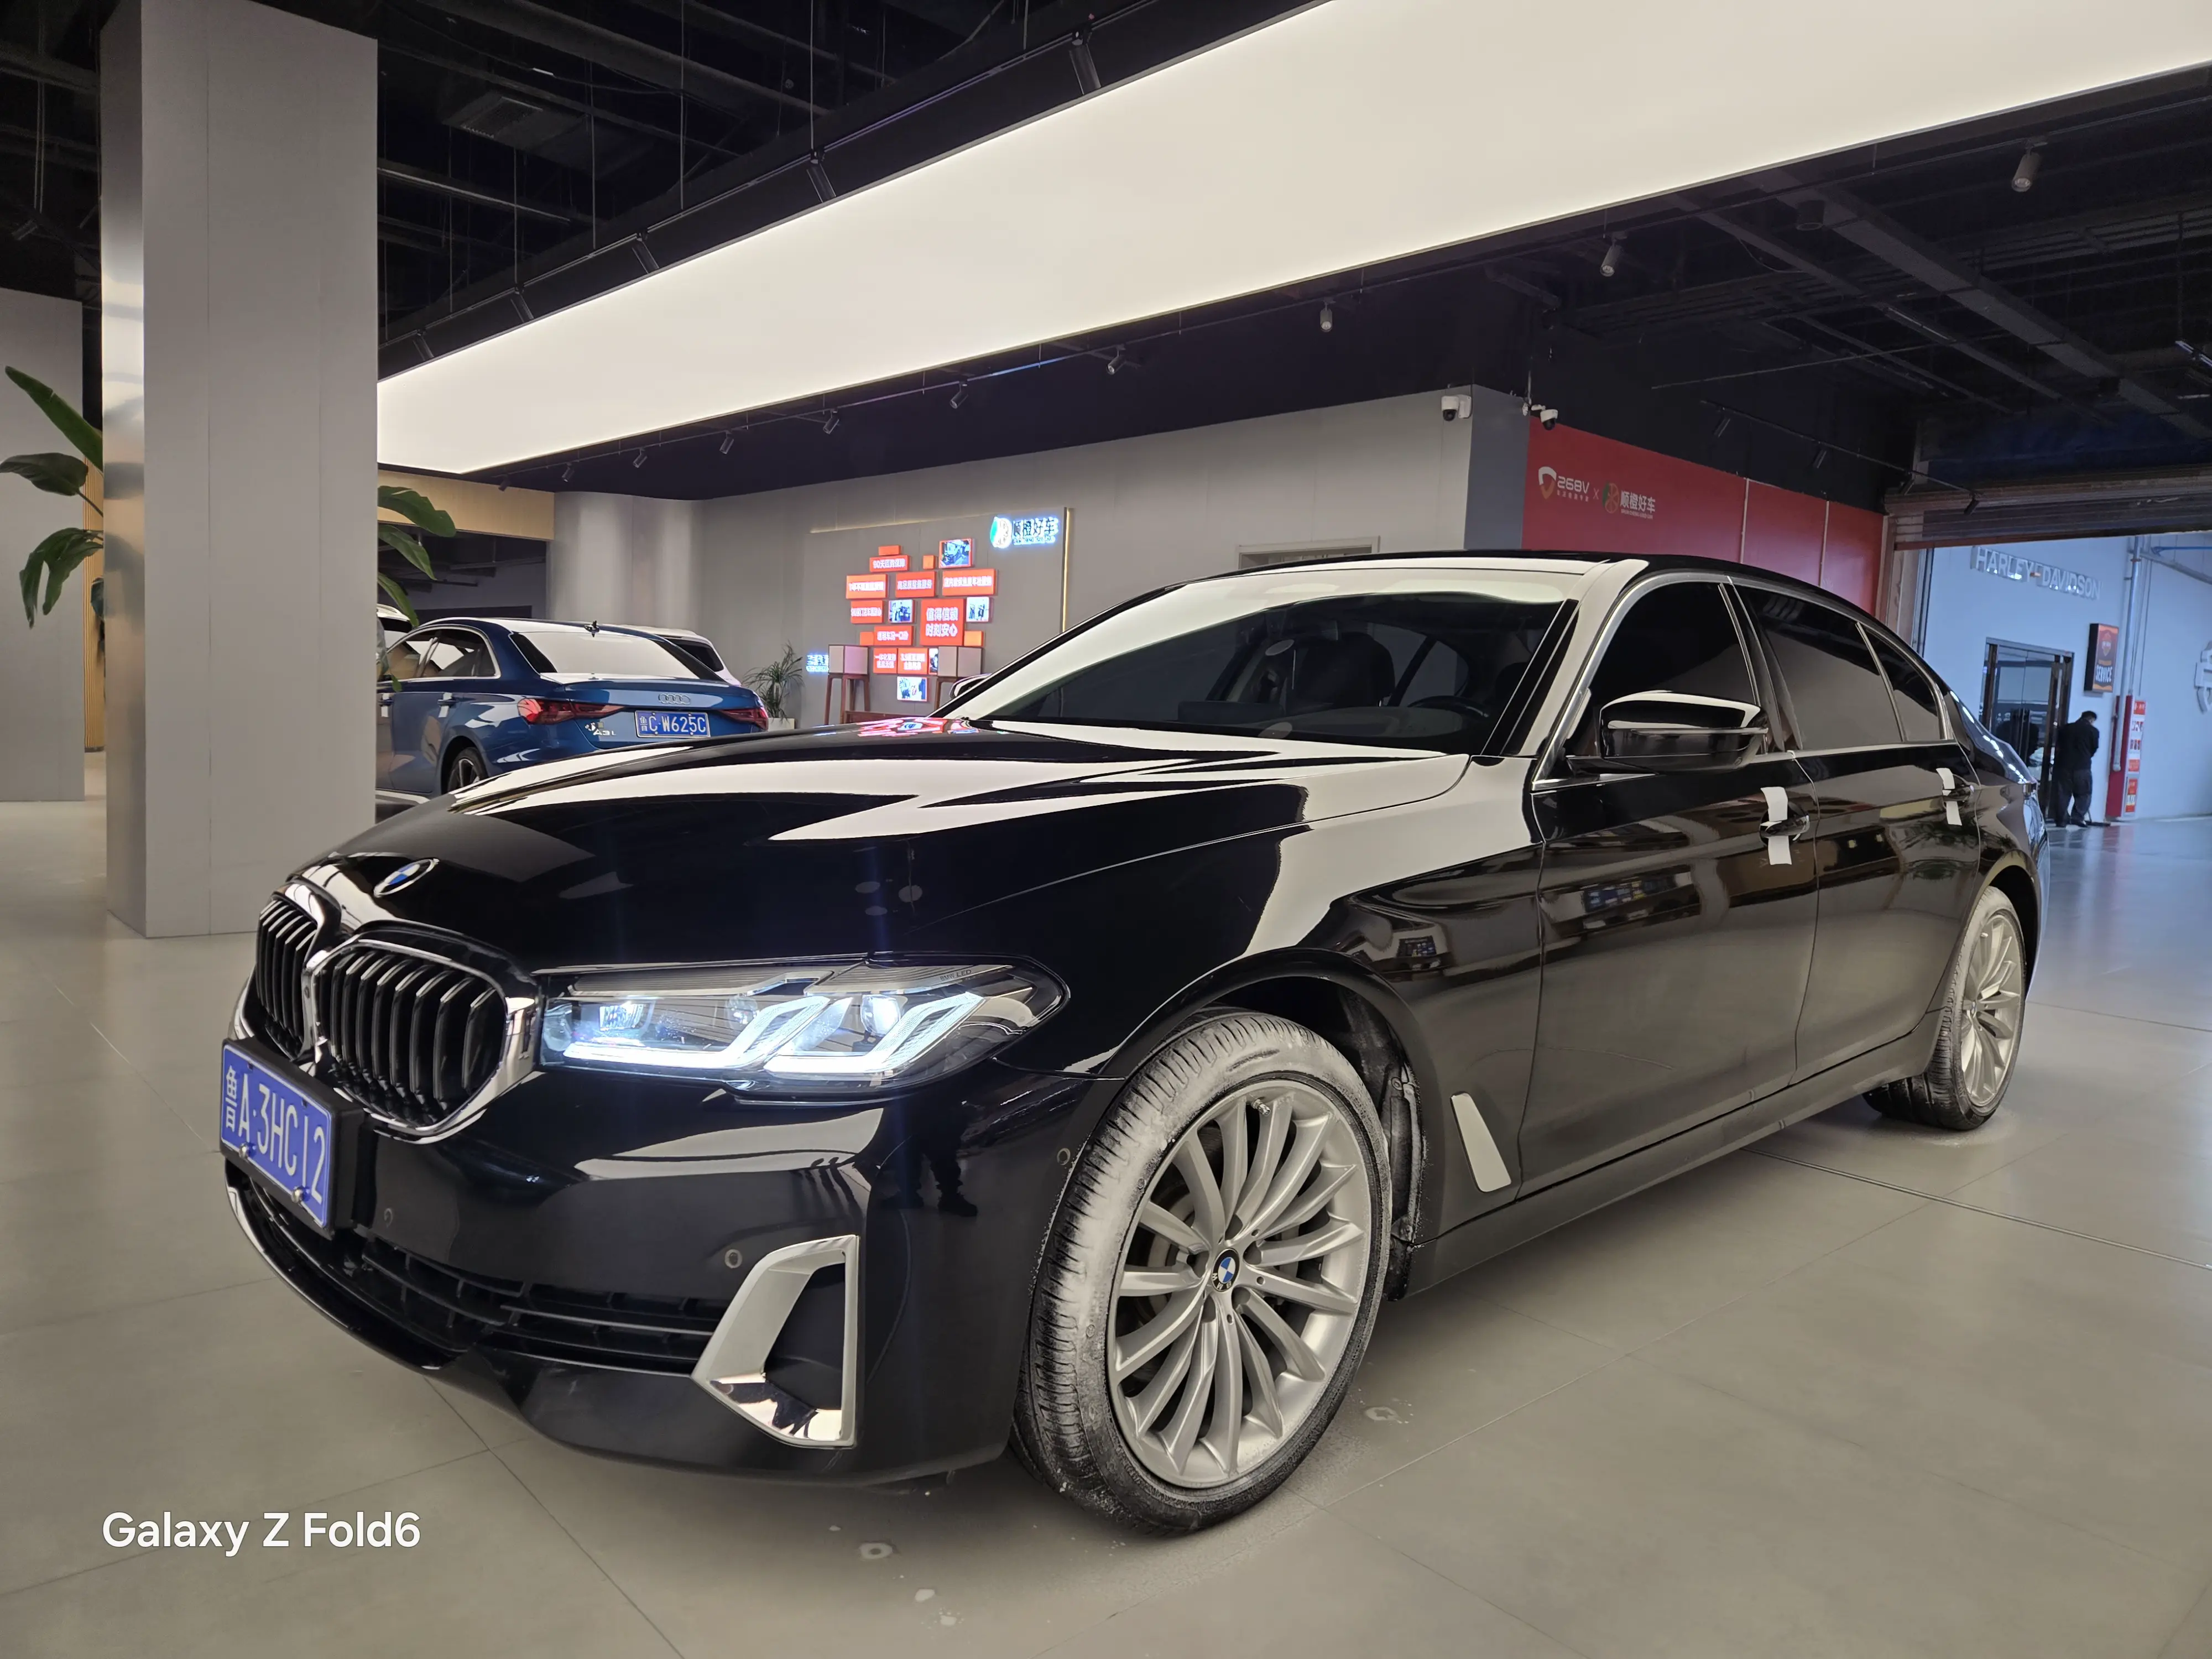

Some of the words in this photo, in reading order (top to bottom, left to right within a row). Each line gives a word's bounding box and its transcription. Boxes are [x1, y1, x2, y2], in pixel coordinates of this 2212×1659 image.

[1557, 476, 1589, 494] 268V
[1620, 490, 1656, 514] 顺橙好车
[926, 607, 958, 622] 值得信赖
[925, 623, 958, 637] 时刻安心
[2095, 664, 2113, 683] SERVICE
